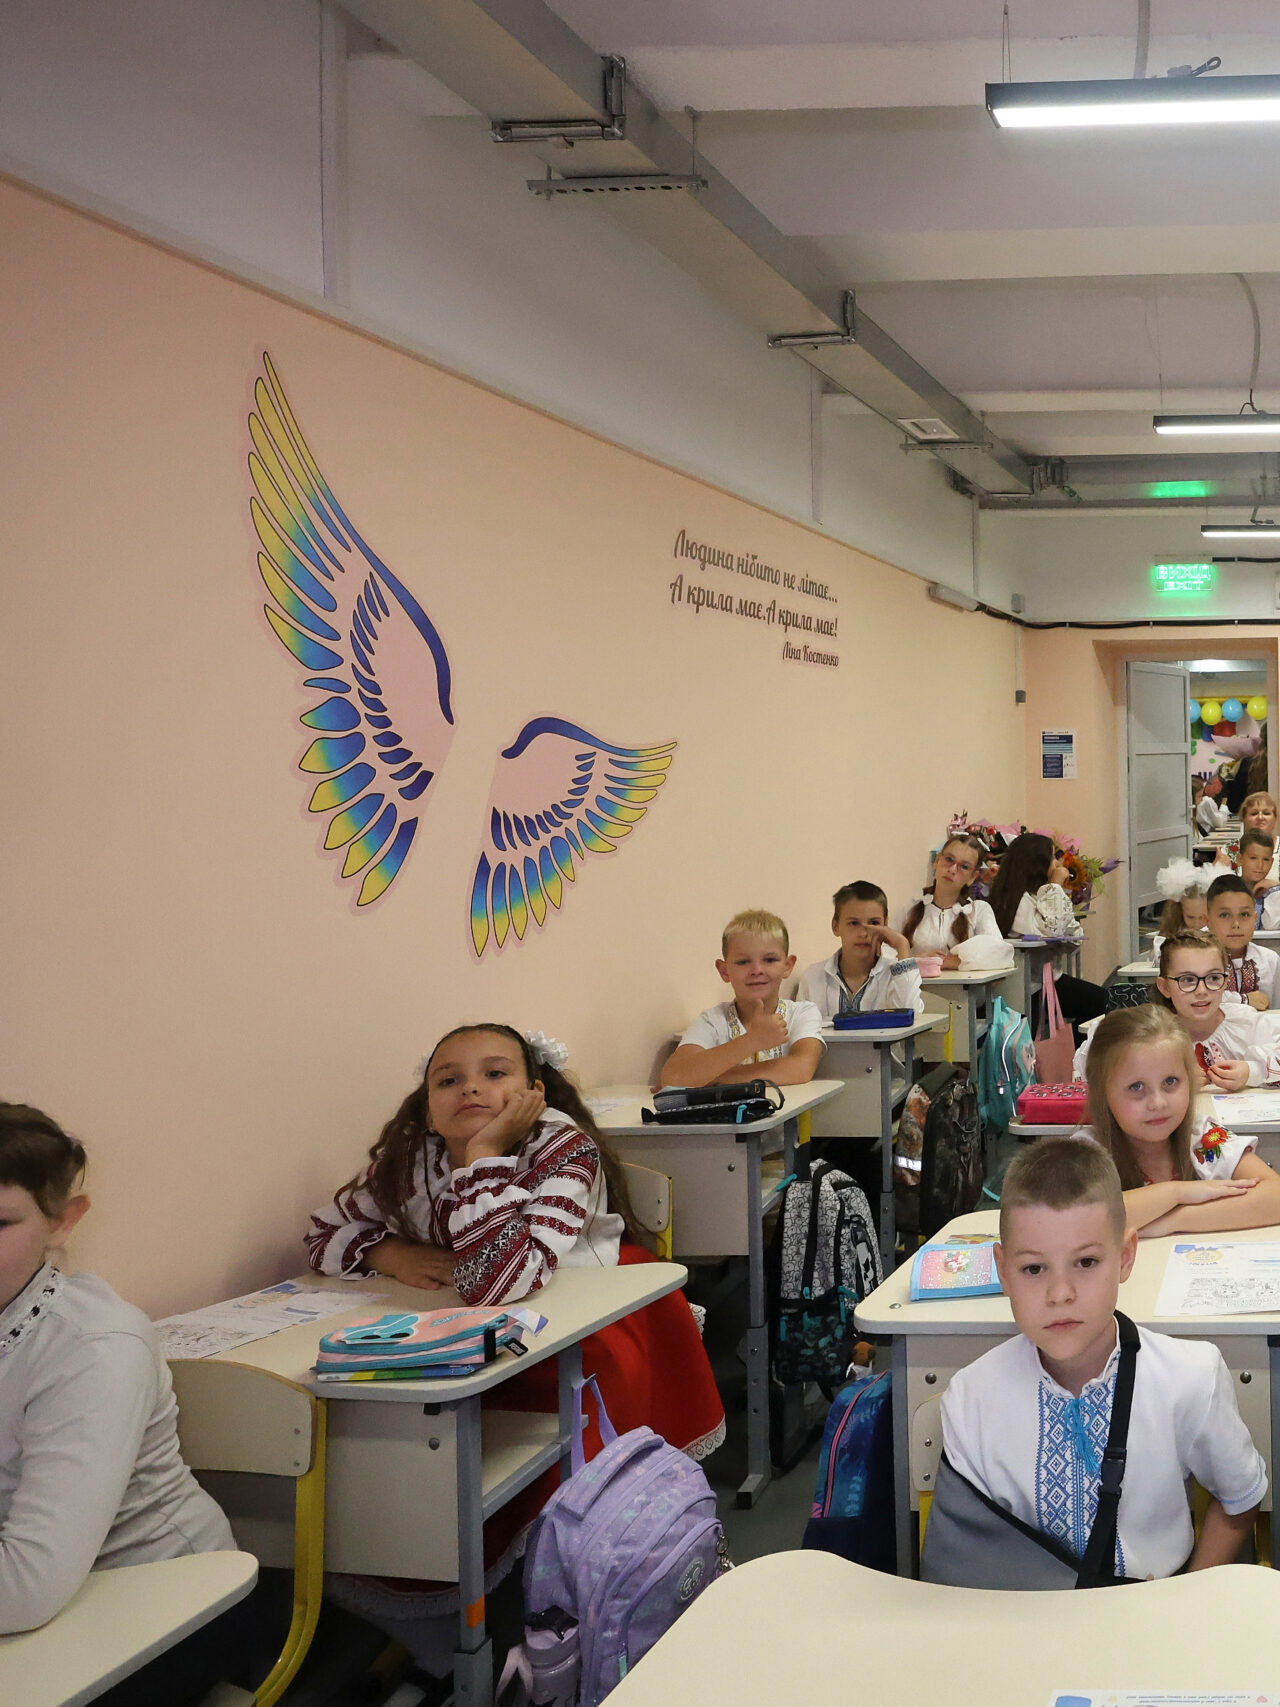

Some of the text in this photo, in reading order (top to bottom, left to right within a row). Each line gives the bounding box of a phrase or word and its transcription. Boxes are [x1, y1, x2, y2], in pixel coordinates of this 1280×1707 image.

[673, 529, 734, 571] Людина
[737, 553, 781, 586] нібито
[783, 570, 796, 590] не
[1155, 565, 1211, 581] ВИХІД
[1163, 580, 1204, 591] EXIT
[669, 574, 684, 604] А
[686, 584, 733, 614] крила
[778, 608, 813, 633] крила
[813, 618, 838, 638] має!
[782, 641, 839, 667] Ліна Костенко
